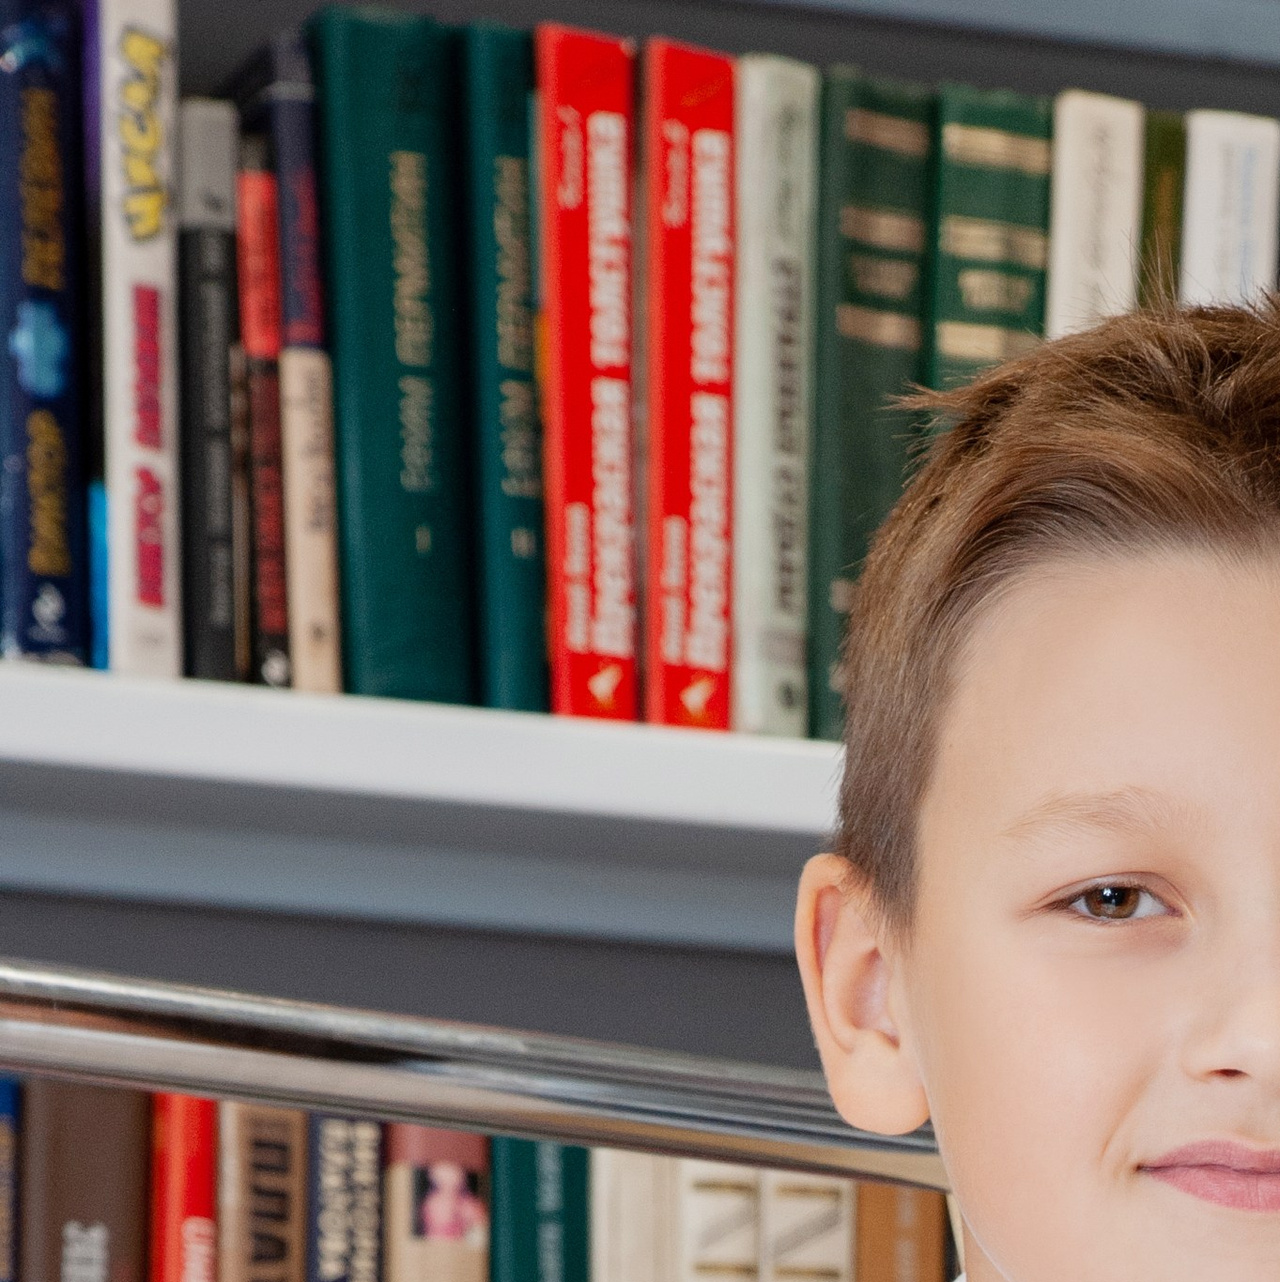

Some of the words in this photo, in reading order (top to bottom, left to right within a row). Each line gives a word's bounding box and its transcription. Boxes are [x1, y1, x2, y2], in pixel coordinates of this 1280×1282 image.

[587, 111, 629, 370] толстушка
[690, 128, 732, 384] толстушка
[591, 376, 632, 658] Прекрасная
[686, 391, 729, 671] Прекрасная
